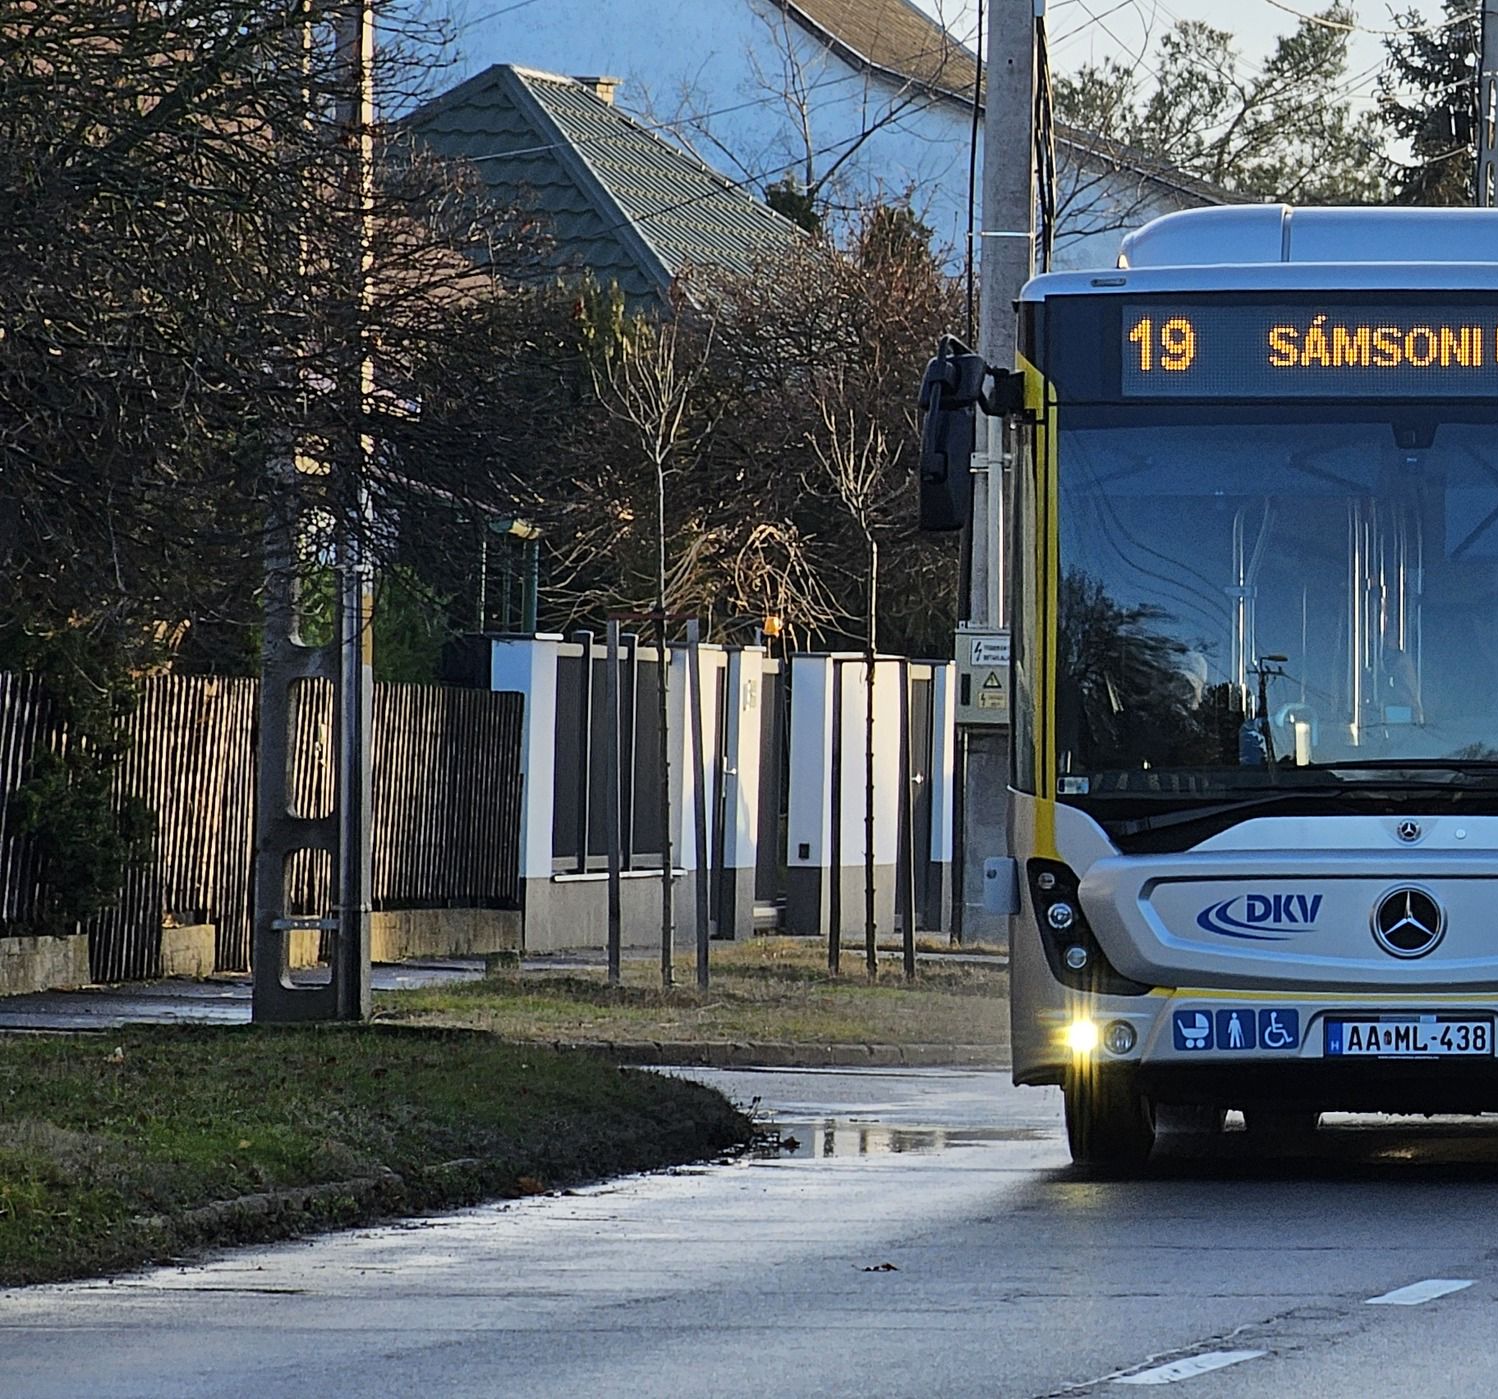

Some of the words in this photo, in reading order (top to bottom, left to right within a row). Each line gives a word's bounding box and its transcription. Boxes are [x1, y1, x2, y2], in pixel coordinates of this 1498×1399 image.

[1129, 319, 1194, 371] 19
[1269, 315, 1482, 367] SÁMSONI
[1246, 895, 1323, 923] DKV
